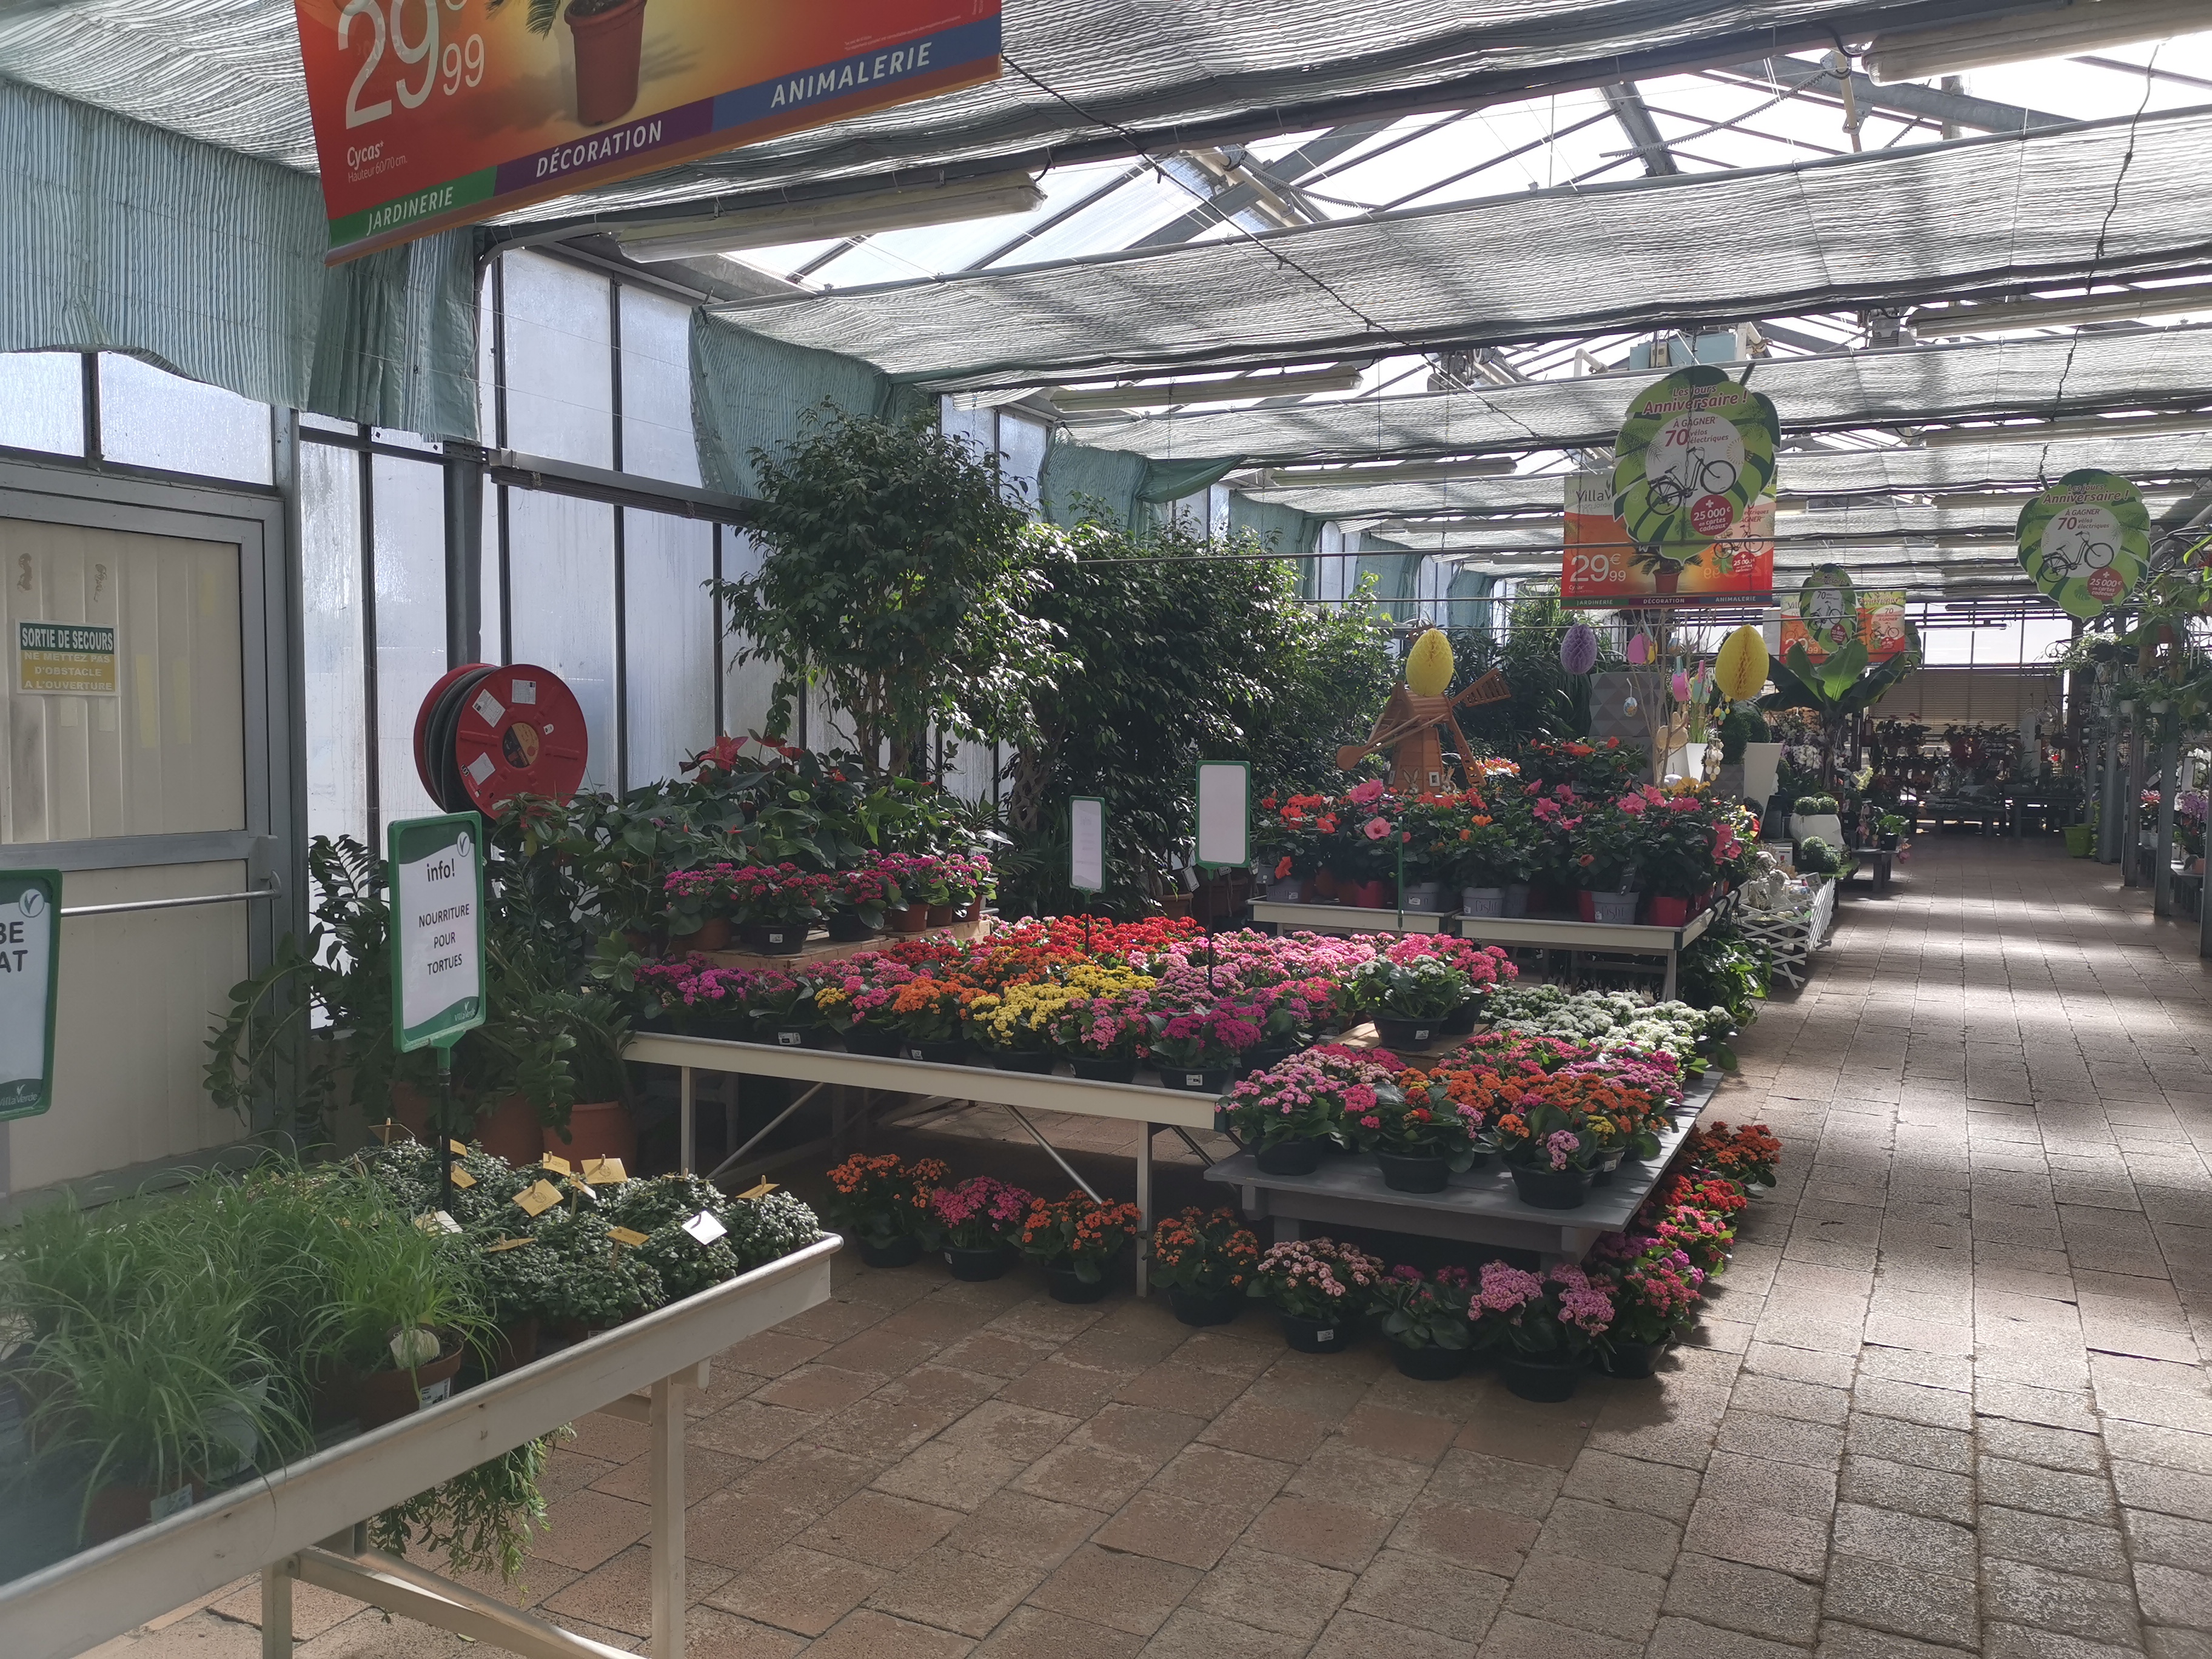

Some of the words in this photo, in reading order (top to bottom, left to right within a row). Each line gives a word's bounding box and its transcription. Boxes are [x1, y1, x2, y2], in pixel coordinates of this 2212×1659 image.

[338, 0, 440, 130] 29
[442, 33, 484, 96] 99
[771, 42, 933, 109] ANIMALERIE
[536, 120, 662, 178] DÉCORATION
[348, 167, 375, 183] Hauteur
[366, 186, 454, 236] JARDINERIE
[1672, 387, 1689, 397] Les
[1643, 392, 1738, 415] Anniversaire
[1672, 418, 1680, 428] À
[1664, 429, 1689, 447] 70
[1690, 434, 1729, 444] électriques
[2081, 484, 2104, 492] jours
[2042, 491, 2120, 504] Anniversaire
[1694, 510, 1706, 521] 25
[1707, 507, 1726, 519] 000
[1706, 517, 1726, 526] cartes
[2057, 517, 2077, 531] 70
[1570, 554, 1609, 582] 29
[1609, 570, 1626, 581] 99
[22, 627, 56, 648] SORTIE
[58, 629, 70, 649] DE
[72, 630, 113, 651] SECOURS
[24, 652, 40, 660] NE
[44, 652, 88, 662] METTEZ
[91, 655, 110, 663] PAS
[34, 666, 102, 677] D'OBSTACLE
[36, 680, 113, 691] L'OUVERTURE
[426, 857, 456, 882] info!
[418, 903, 470, 928] NOURRITURE
[434, 931, 455, 949] POUR
[427, 953, 462, 975] TORTUES
